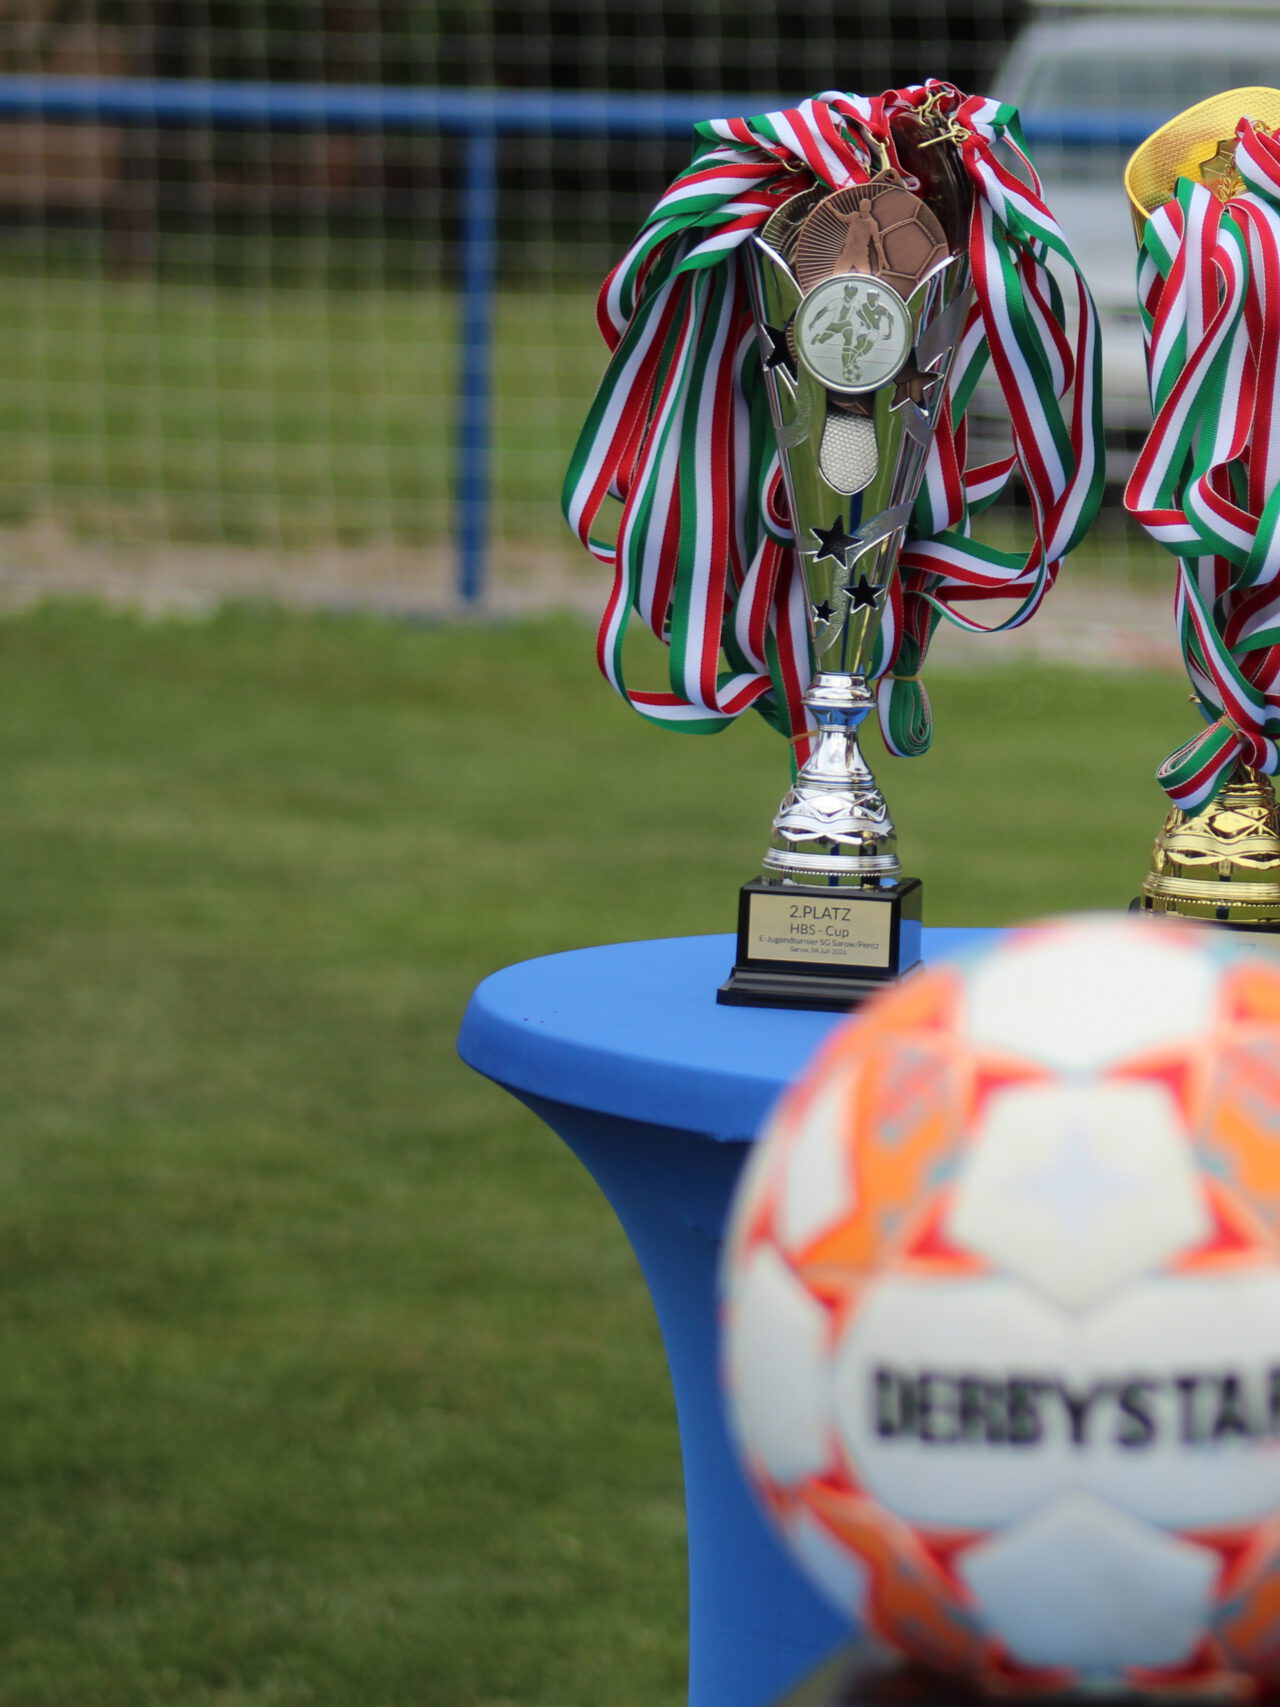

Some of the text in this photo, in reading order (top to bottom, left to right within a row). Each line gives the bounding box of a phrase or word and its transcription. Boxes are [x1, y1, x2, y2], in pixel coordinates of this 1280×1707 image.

[790, 904, 852, 922] 2.PLATZ
[790, 923, 816, 935] HBS
[825, 925, 850, 938] Cup
[820, 939, 831, 947] SG
